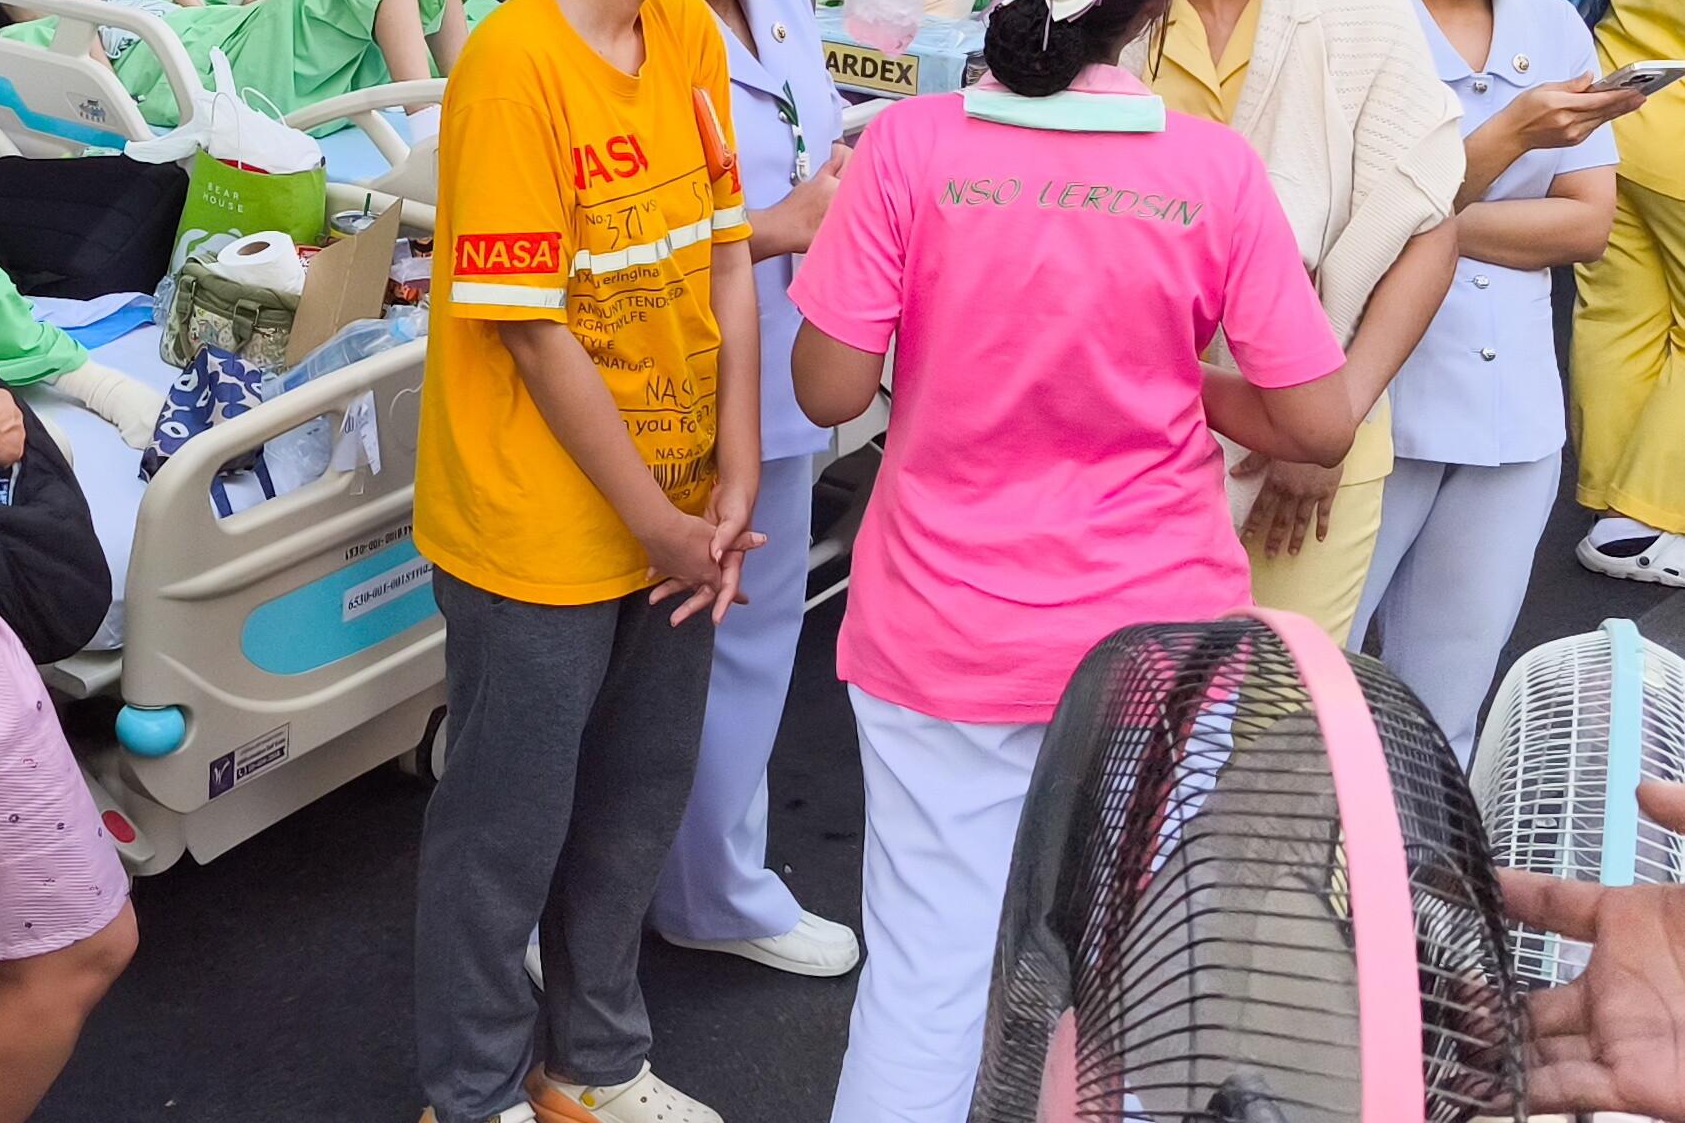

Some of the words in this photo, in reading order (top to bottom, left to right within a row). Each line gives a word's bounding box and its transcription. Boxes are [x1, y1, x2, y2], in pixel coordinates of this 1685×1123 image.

[203, 191, 245, 213] HOUSE
[208, 182, 239, 201] BEAR
[940, 178, 1022, 207] NSO
[1038, 180, 1203, 227] LERDSIN
[462, 239, 554, 269] NASA
[635, 419, 672, 436] you
